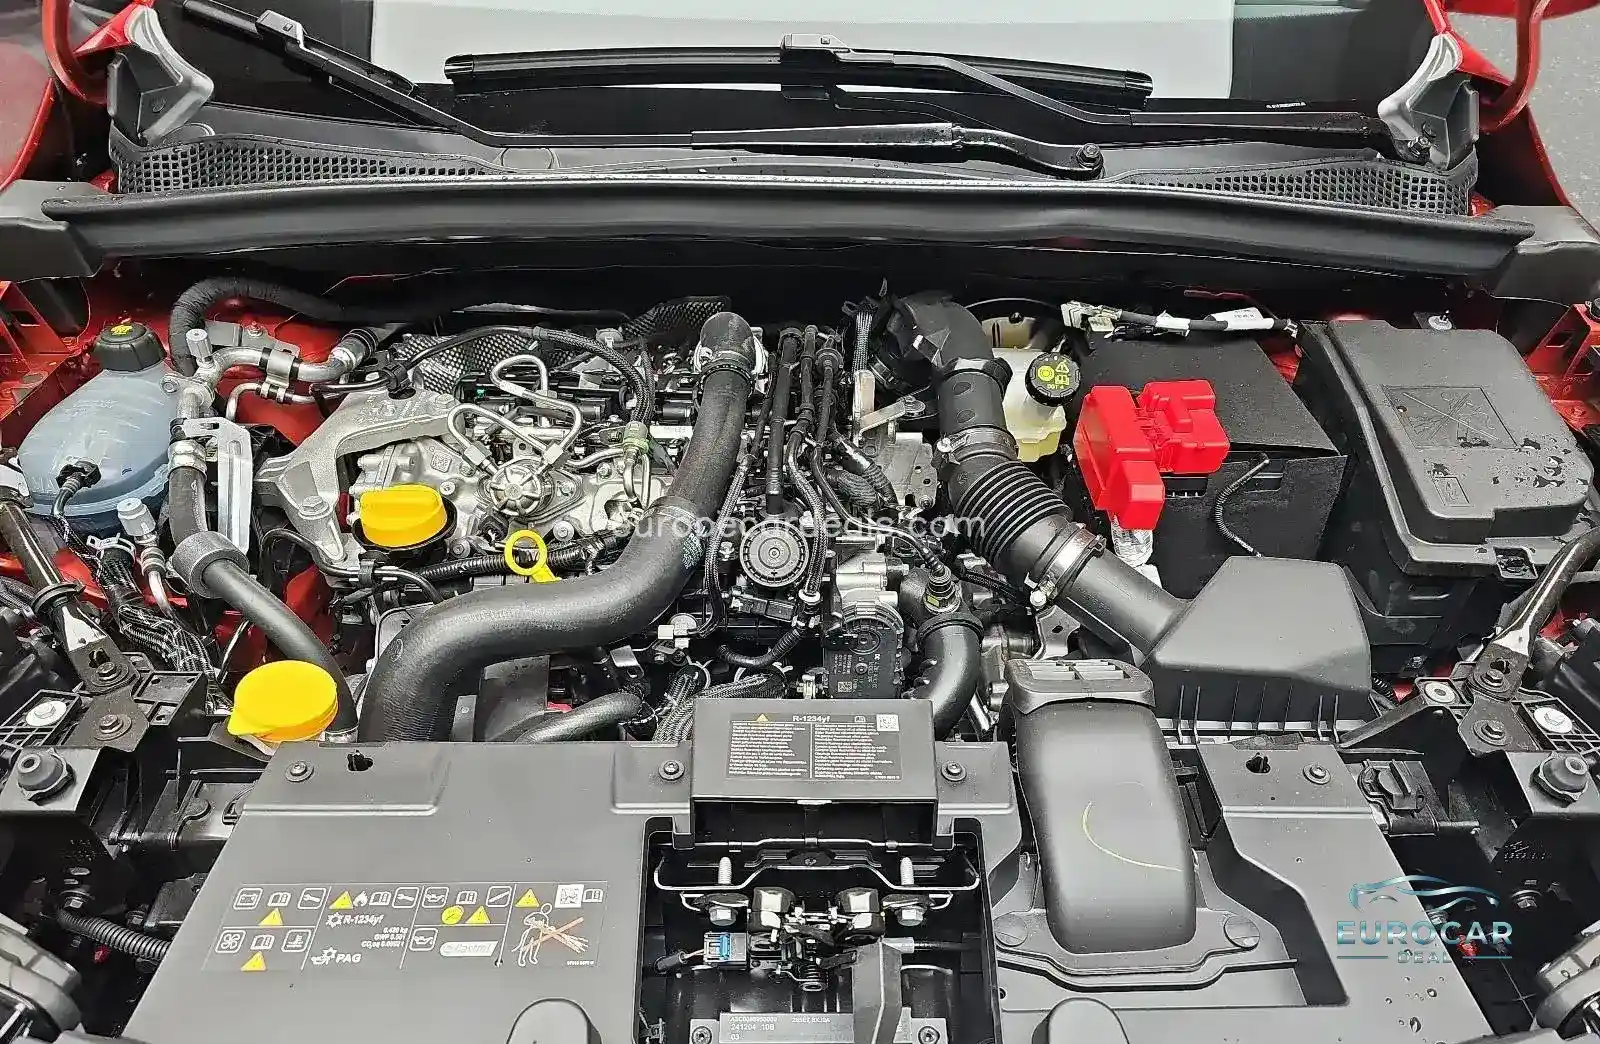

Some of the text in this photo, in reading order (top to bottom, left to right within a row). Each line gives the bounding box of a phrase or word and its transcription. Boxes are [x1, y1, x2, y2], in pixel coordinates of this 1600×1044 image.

[792, 715, 831, 723] R-1234yf
[343, 914, 384, 926] R-1234yf
[335, 953, 361, 963] PAG
[730, 1033, 740, 1041] 03
